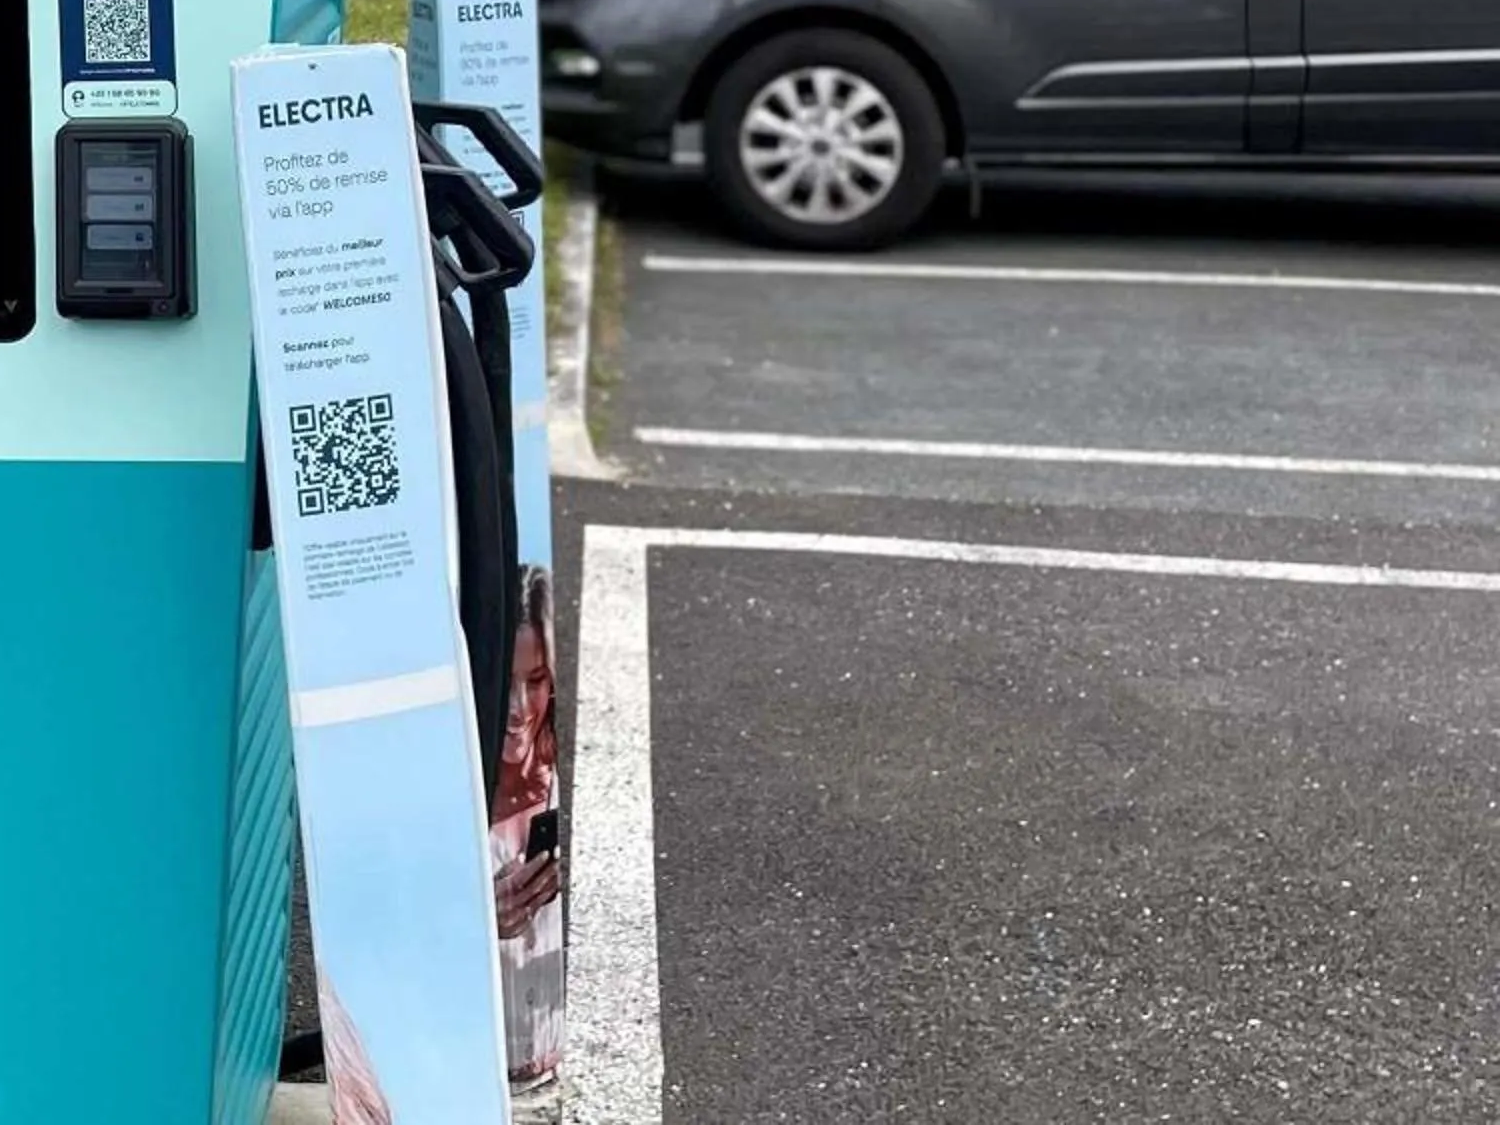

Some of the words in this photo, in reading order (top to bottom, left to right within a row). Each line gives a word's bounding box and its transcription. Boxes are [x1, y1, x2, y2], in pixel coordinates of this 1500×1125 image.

[457, 1, 523, 23] ELECTRA
[258, 92, 373, 129] ELECTRA
[263, 153, 323, 172] Profitez
[327, 148, 349, 165] de
[265, 176, 305, 196] 50%
[309, 175, 331, 191] de
[335, 169, 388, 187] remise
[268, 204, 292, 219] via
[295, 199, 334, 218] l'app
[275, 268, 296, 280] prix
[323, 292, 391, 310] WELCOME50
[283, 340, 329, 353] Scannez
